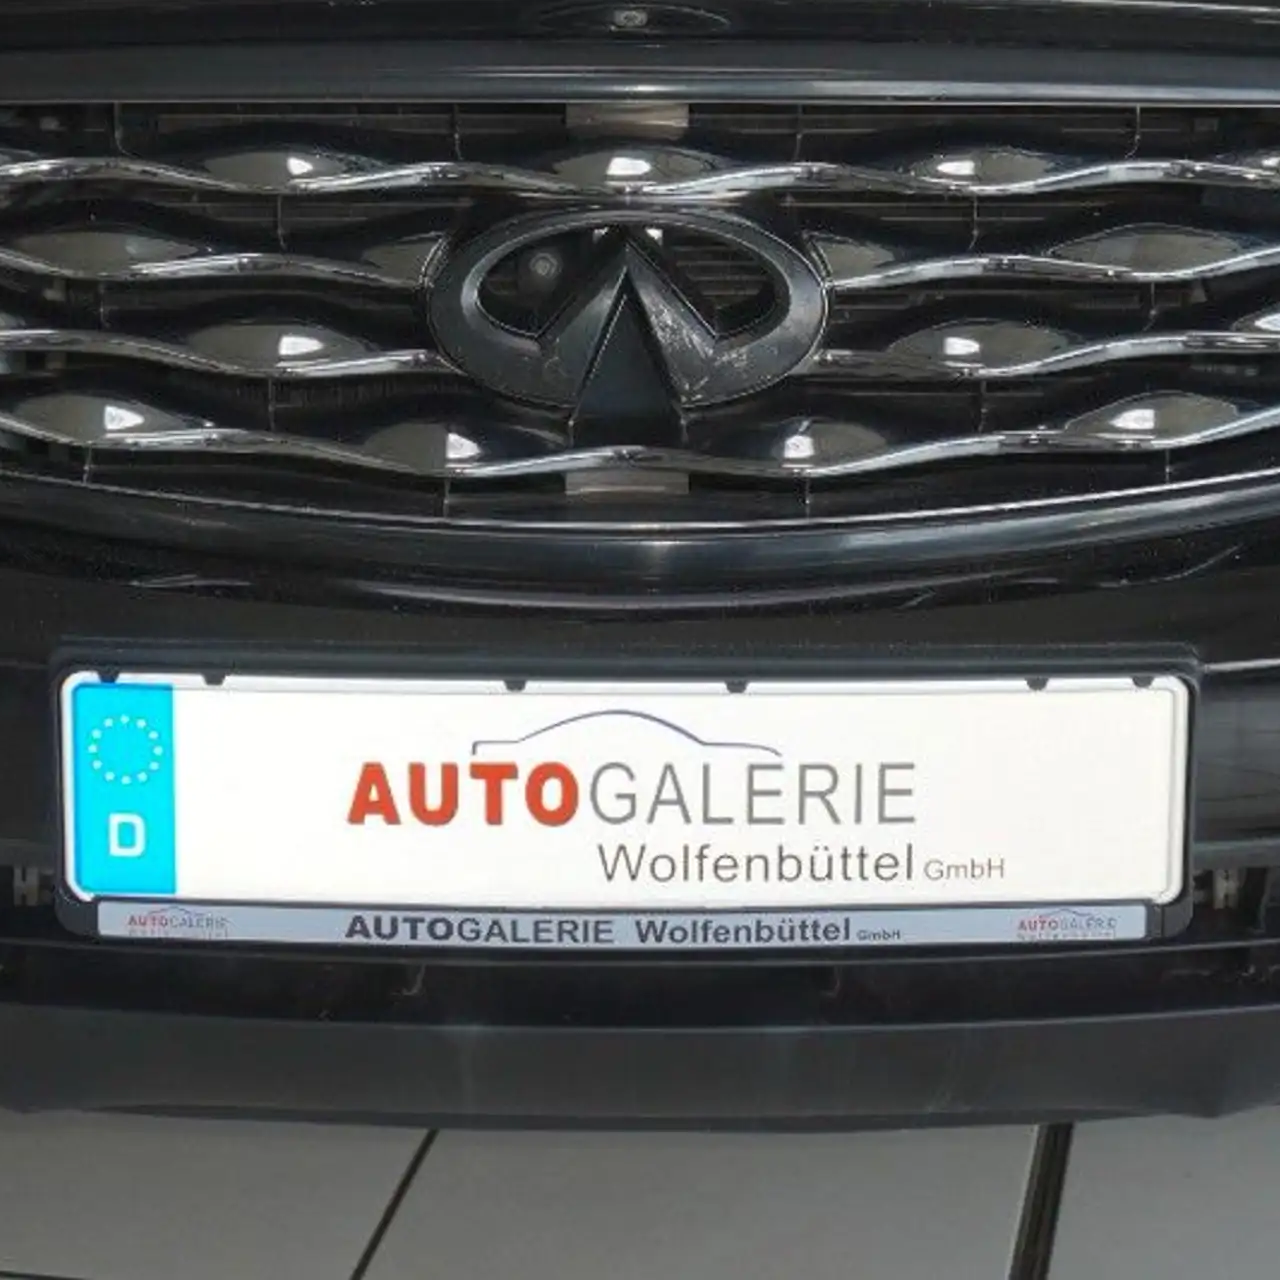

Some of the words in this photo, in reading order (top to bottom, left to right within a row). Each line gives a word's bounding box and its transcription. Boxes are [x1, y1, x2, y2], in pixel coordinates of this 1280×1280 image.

[347, 761, 916, 827] AUTOGALERIE
[109, 812, 146, 857] D
[598, 843, 914, 884] Wolfenbüttel
[923, 857, 1005, 881] GmbH
[345, 915, 614, 944] AUTOGALERIE
[635, 918, 850, 944] Wolfenbüttel
[856, 928, 902, 941] GmbH
